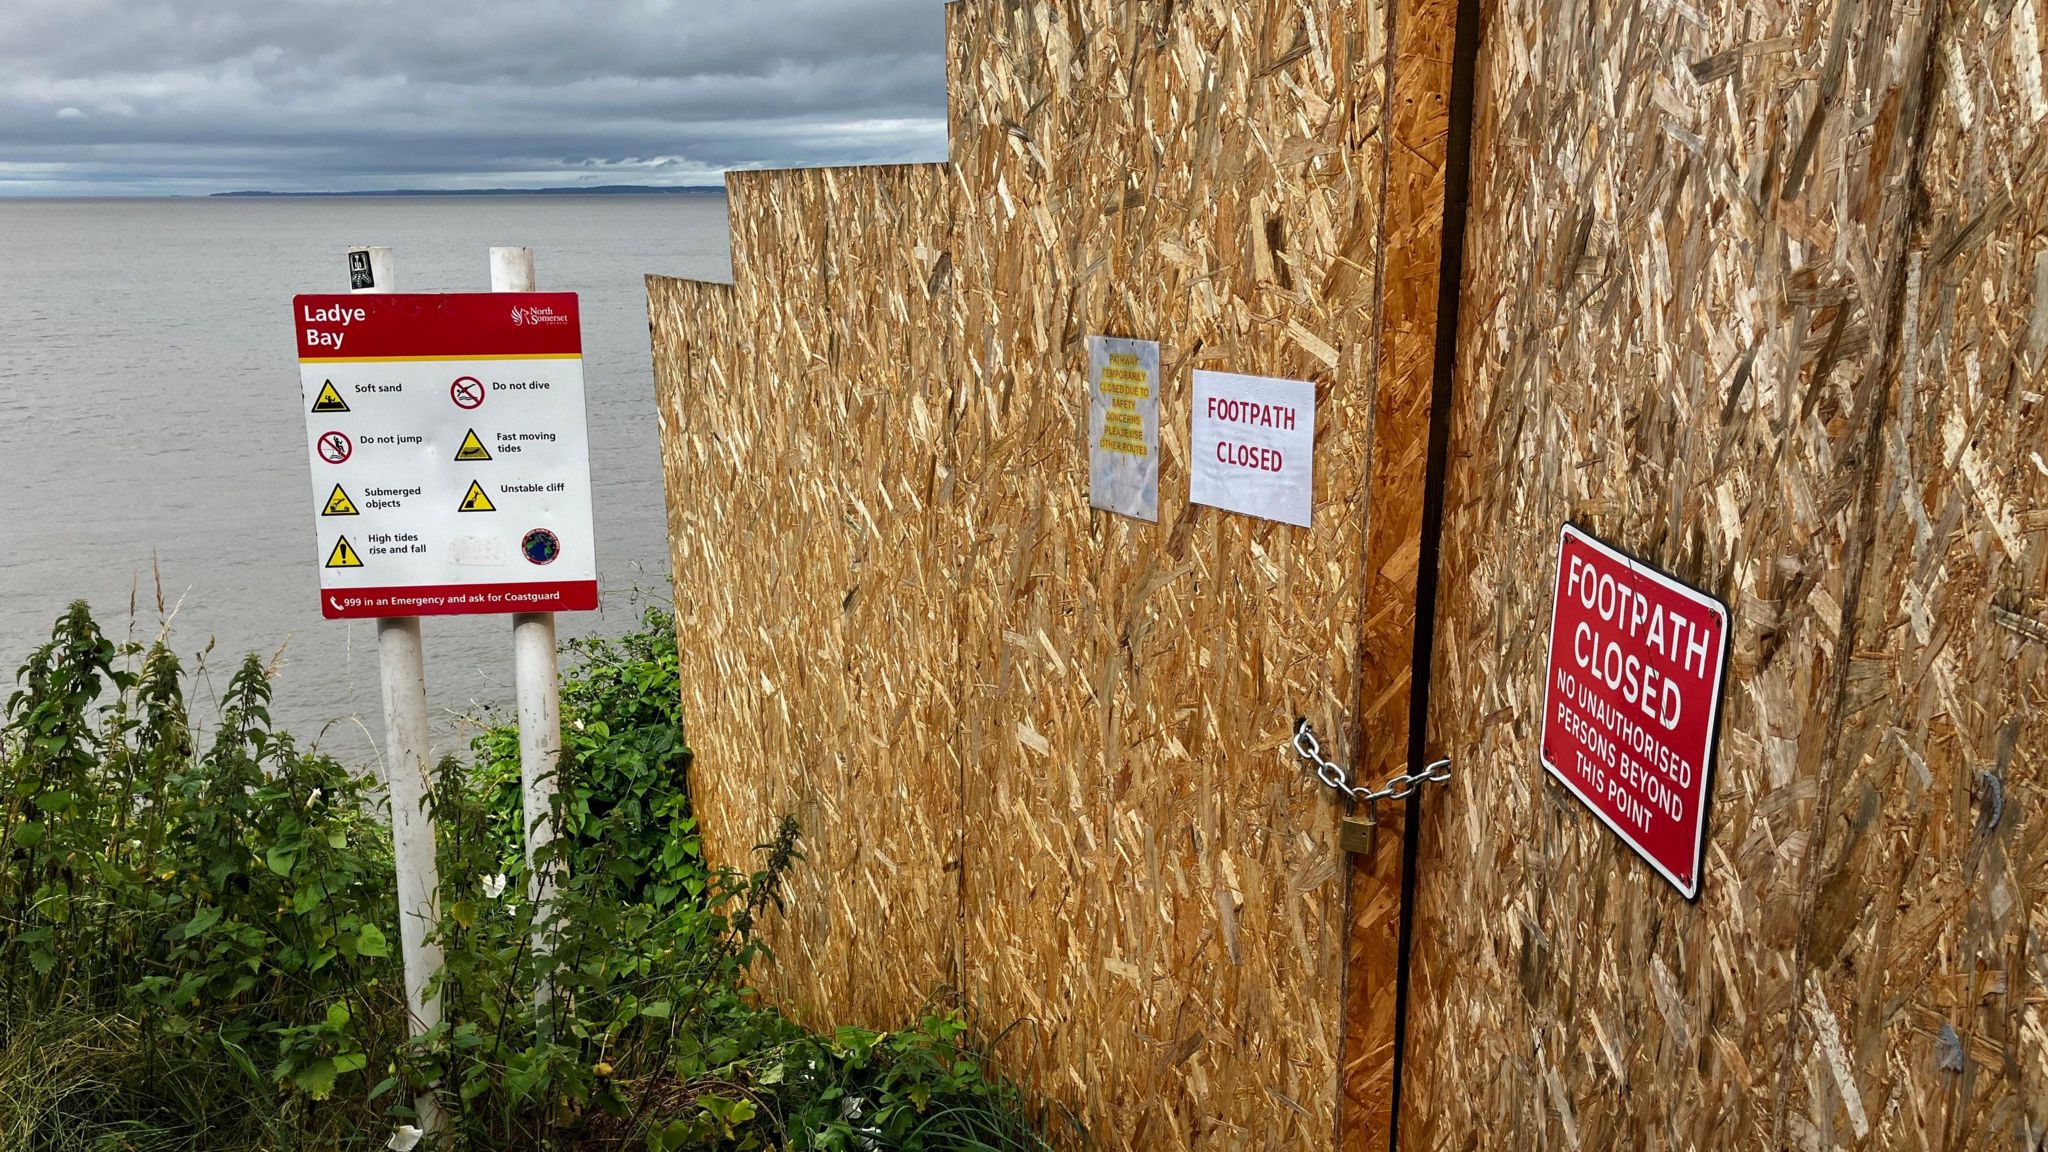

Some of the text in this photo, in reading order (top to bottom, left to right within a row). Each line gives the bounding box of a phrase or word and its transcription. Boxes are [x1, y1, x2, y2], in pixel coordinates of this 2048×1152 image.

[304, 304, 366, 326] Ladye
[530, 306, 553, 315] North
[531, 315, 568, 324] Somerset
[306, 329, 344, 349] Bay
[1110, 354, 1138, 366] PATHWAY
[1103, 369, 1146, 382] TEMPORARILY
[355, 384, 402, 393] Soft sand
[492, 380, 550, 390] Do not dive
[1100, 383, 1150, 398] CLOSED DUE TO
[1112, 399, 1136, 410] SAFETY
[1106, 412, 1140, 425] CONCERNS
[1208, 397, 1296, 431] FOOTPATH
[360, 434, 423, 445] Do not jump
[497, 432, 556, 443] Fast moving
[1104, 426, 1143, 440] PLEASE USE
[498, 444, 522, 453] tides
[1100, 440, 1148, 455] OTHER ROUTES
[1216, 441, 1282, 473] CLOSED
[365, 487, 421, 499] Submerged
[500, 483, 565, 493] Unstable cliff
[366, 499, 401, 510] objects
[368, 533, 418, 544] High tides
[369, 544, 427, 555] rise and fall
[344, 591, 560, 608] 999 in an Emergency and ask for Coastguard
[1567, 554, 1710, 679] FOOTPATH
[1574, 621, 1681, 731] CLOSED
[1557, 667, 1692, 790] NO UNAUTHORISED
[1557, 701, 1683, 823] PERSONS BEYOND
[1575, 750, 1653, 834] THIS POINT
